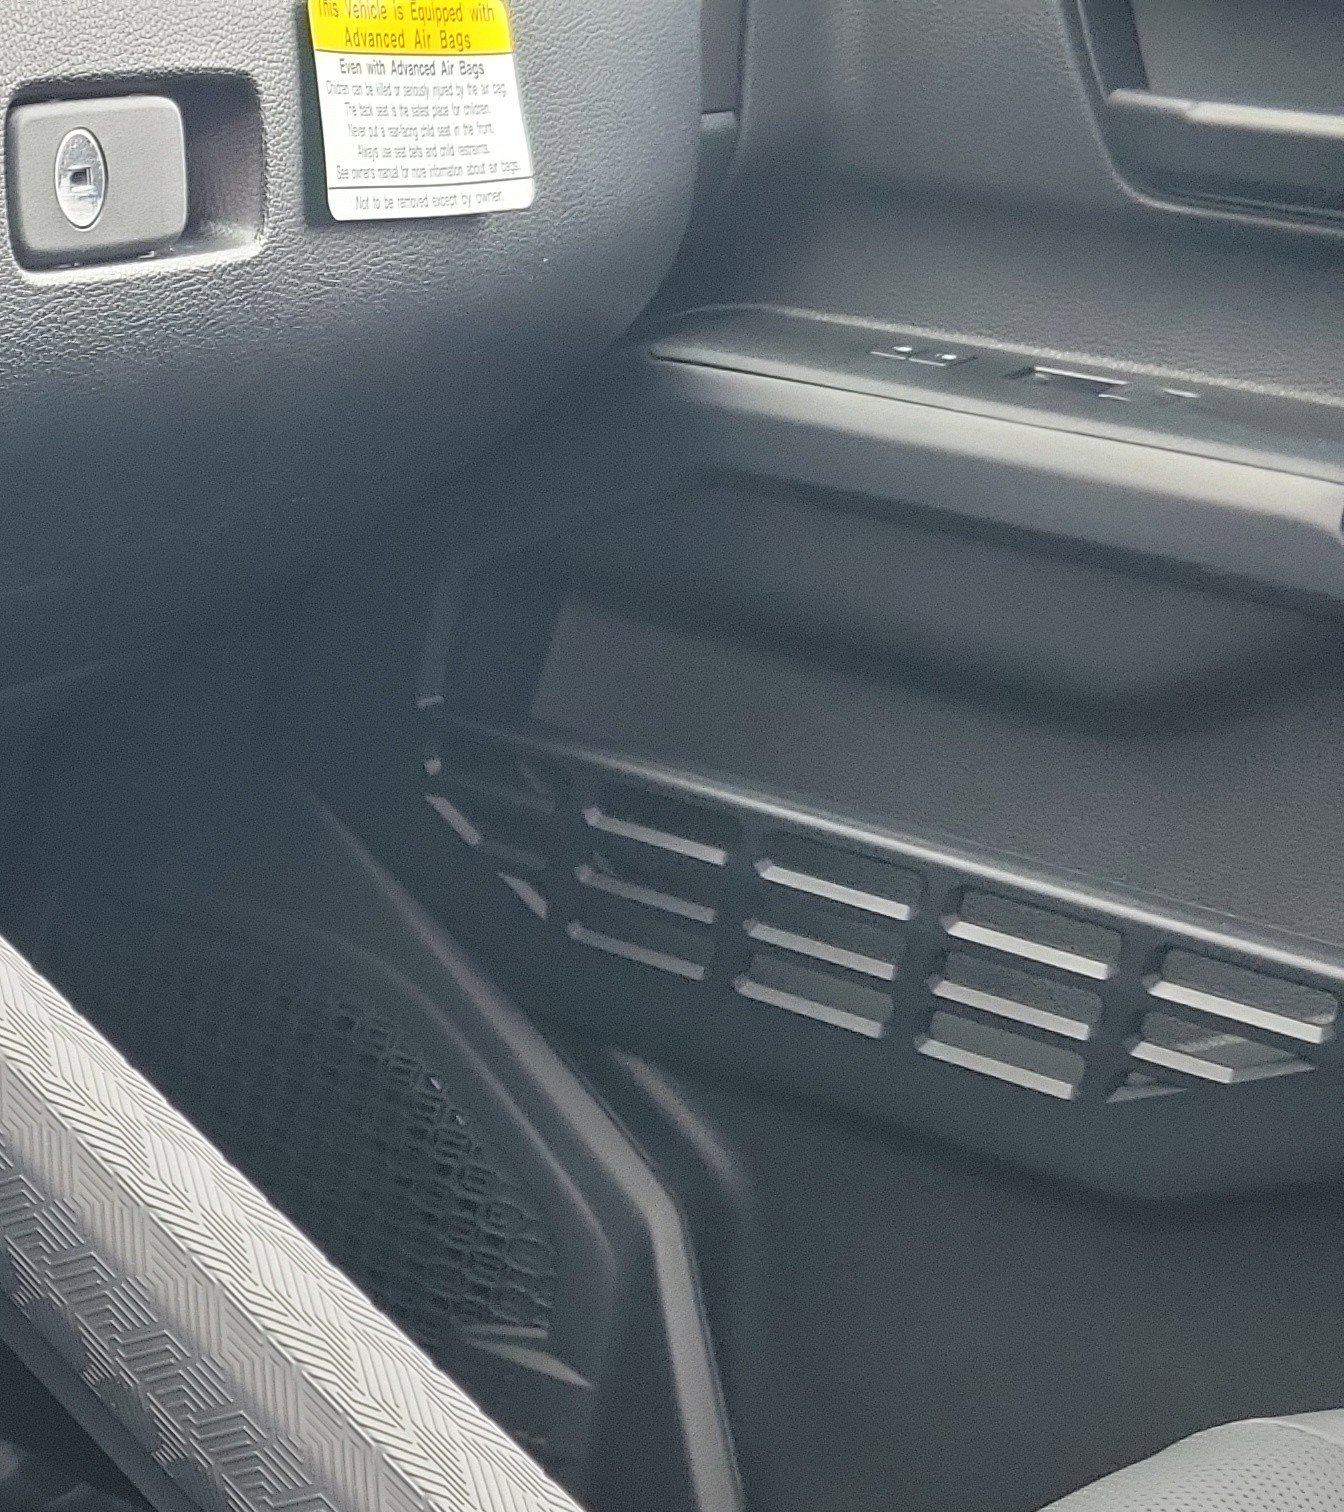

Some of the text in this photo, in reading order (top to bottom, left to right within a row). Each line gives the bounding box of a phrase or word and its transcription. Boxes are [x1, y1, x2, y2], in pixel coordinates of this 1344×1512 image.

[317, 0, 494, 27] This Vehicle is Equipped with
[345, 27, 471, 52] Advanced Air Bags
[339, 58, 485, 79] Even with Advanced Air Bags
